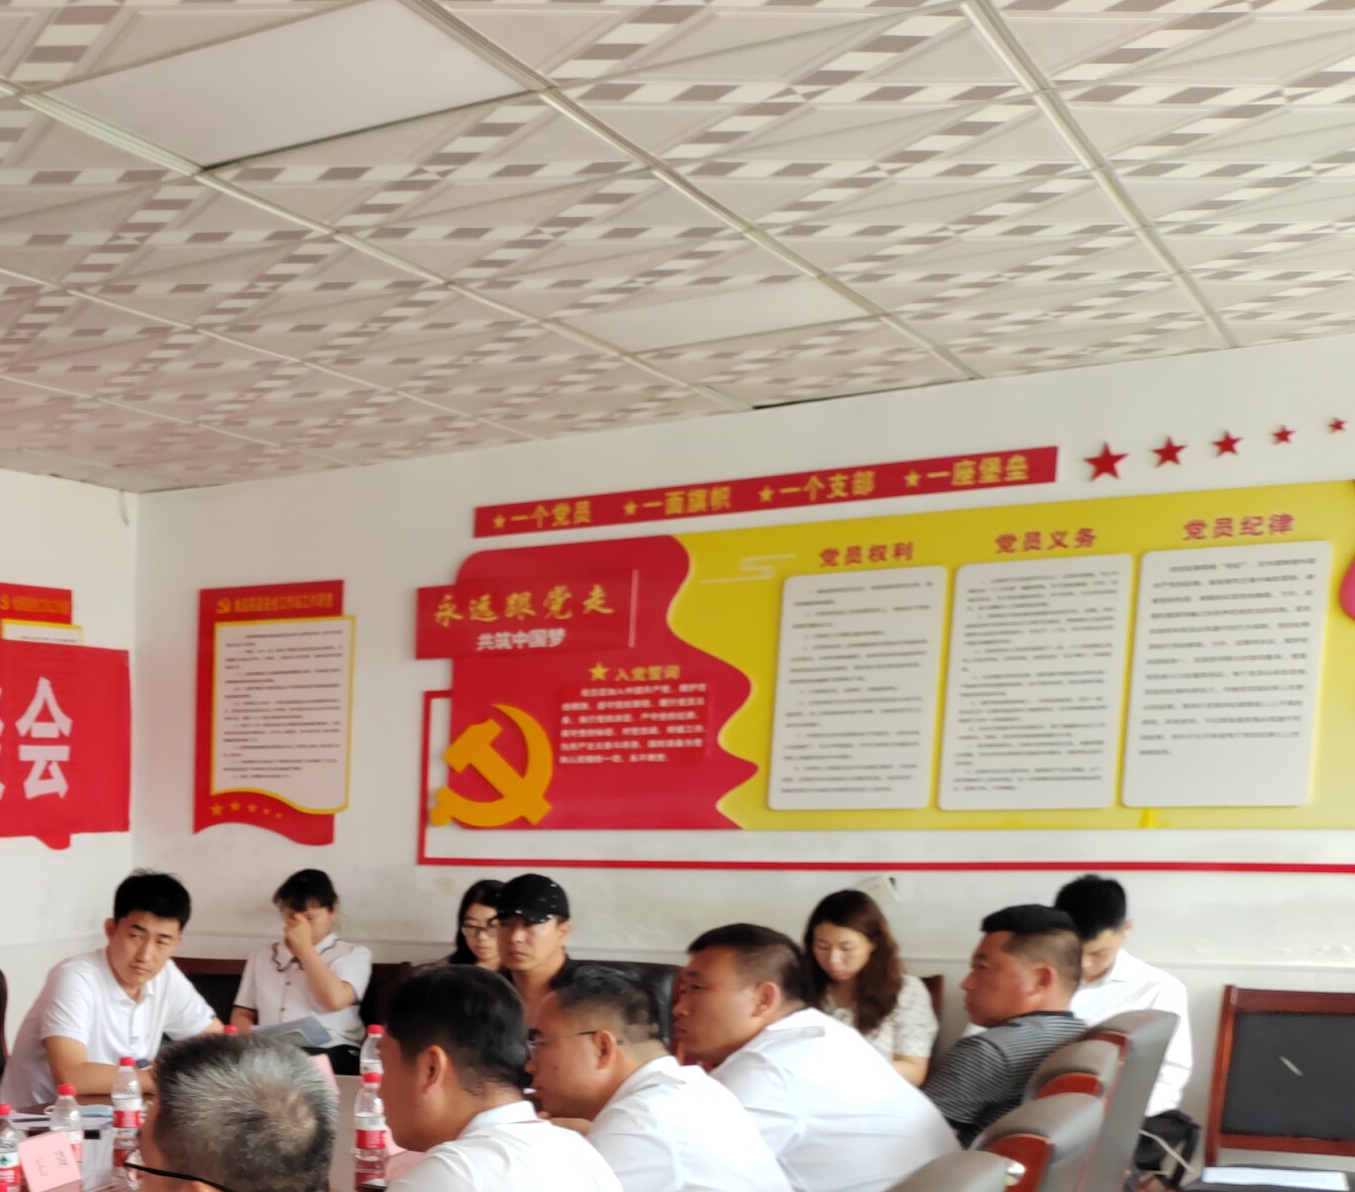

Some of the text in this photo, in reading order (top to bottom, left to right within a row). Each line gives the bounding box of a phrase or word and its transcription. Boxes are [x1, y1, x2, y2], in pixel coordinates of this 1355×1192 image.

[510, 500, 591, 528] 一个党员
[779, 470, 876, 500] 一个支部
[926, 454, 1029, 487] 一座堡垒
[1183, 514, 1294, 540] 党员纪律
[995, 527, 1097, 554] 党员义务
[819, 542, 914, 567] 党员权利
[434, 584, 615, 627] 永远跟党走
[476, 628, 566, 651] 共筑中国梦
